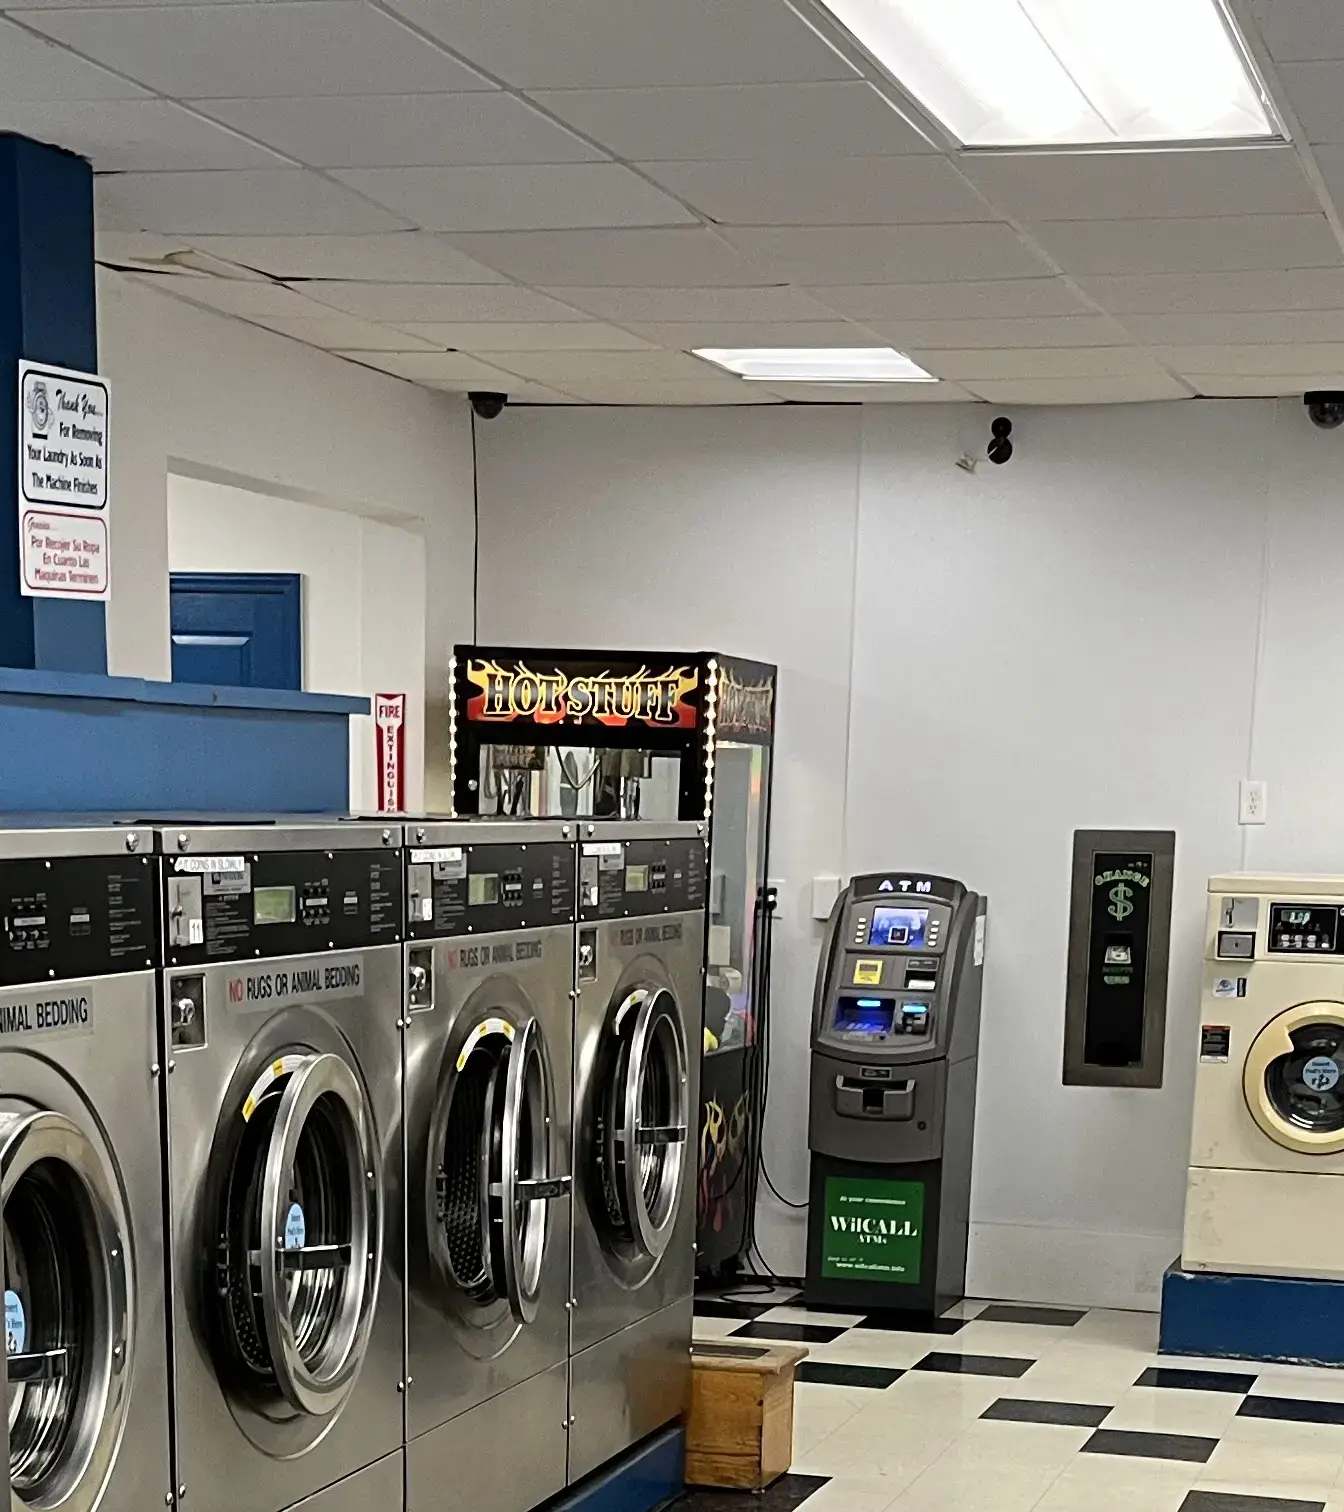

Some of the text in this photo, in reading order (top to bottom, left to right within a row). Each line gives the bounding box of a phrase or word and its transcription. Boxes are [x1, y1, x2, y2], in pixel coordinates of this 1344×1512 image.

[59, 422, 103, 447] For Removing
[27, 444, 103, 469] Your Laundry As Soon As
[32, 472, 98, 495] The Machine Finishes
[483, 672, 680, 720] HOT STUFF
[379, 705, 400, 719] FIRE
[878, 879, 932, 893] ATM
[1094, 869, 1150, 888] CHANGE
[229, 963, 360, 1002] NO RUGS OR ANIMAL BEDDING
[36, 997, 89, 1029] BEDDING
